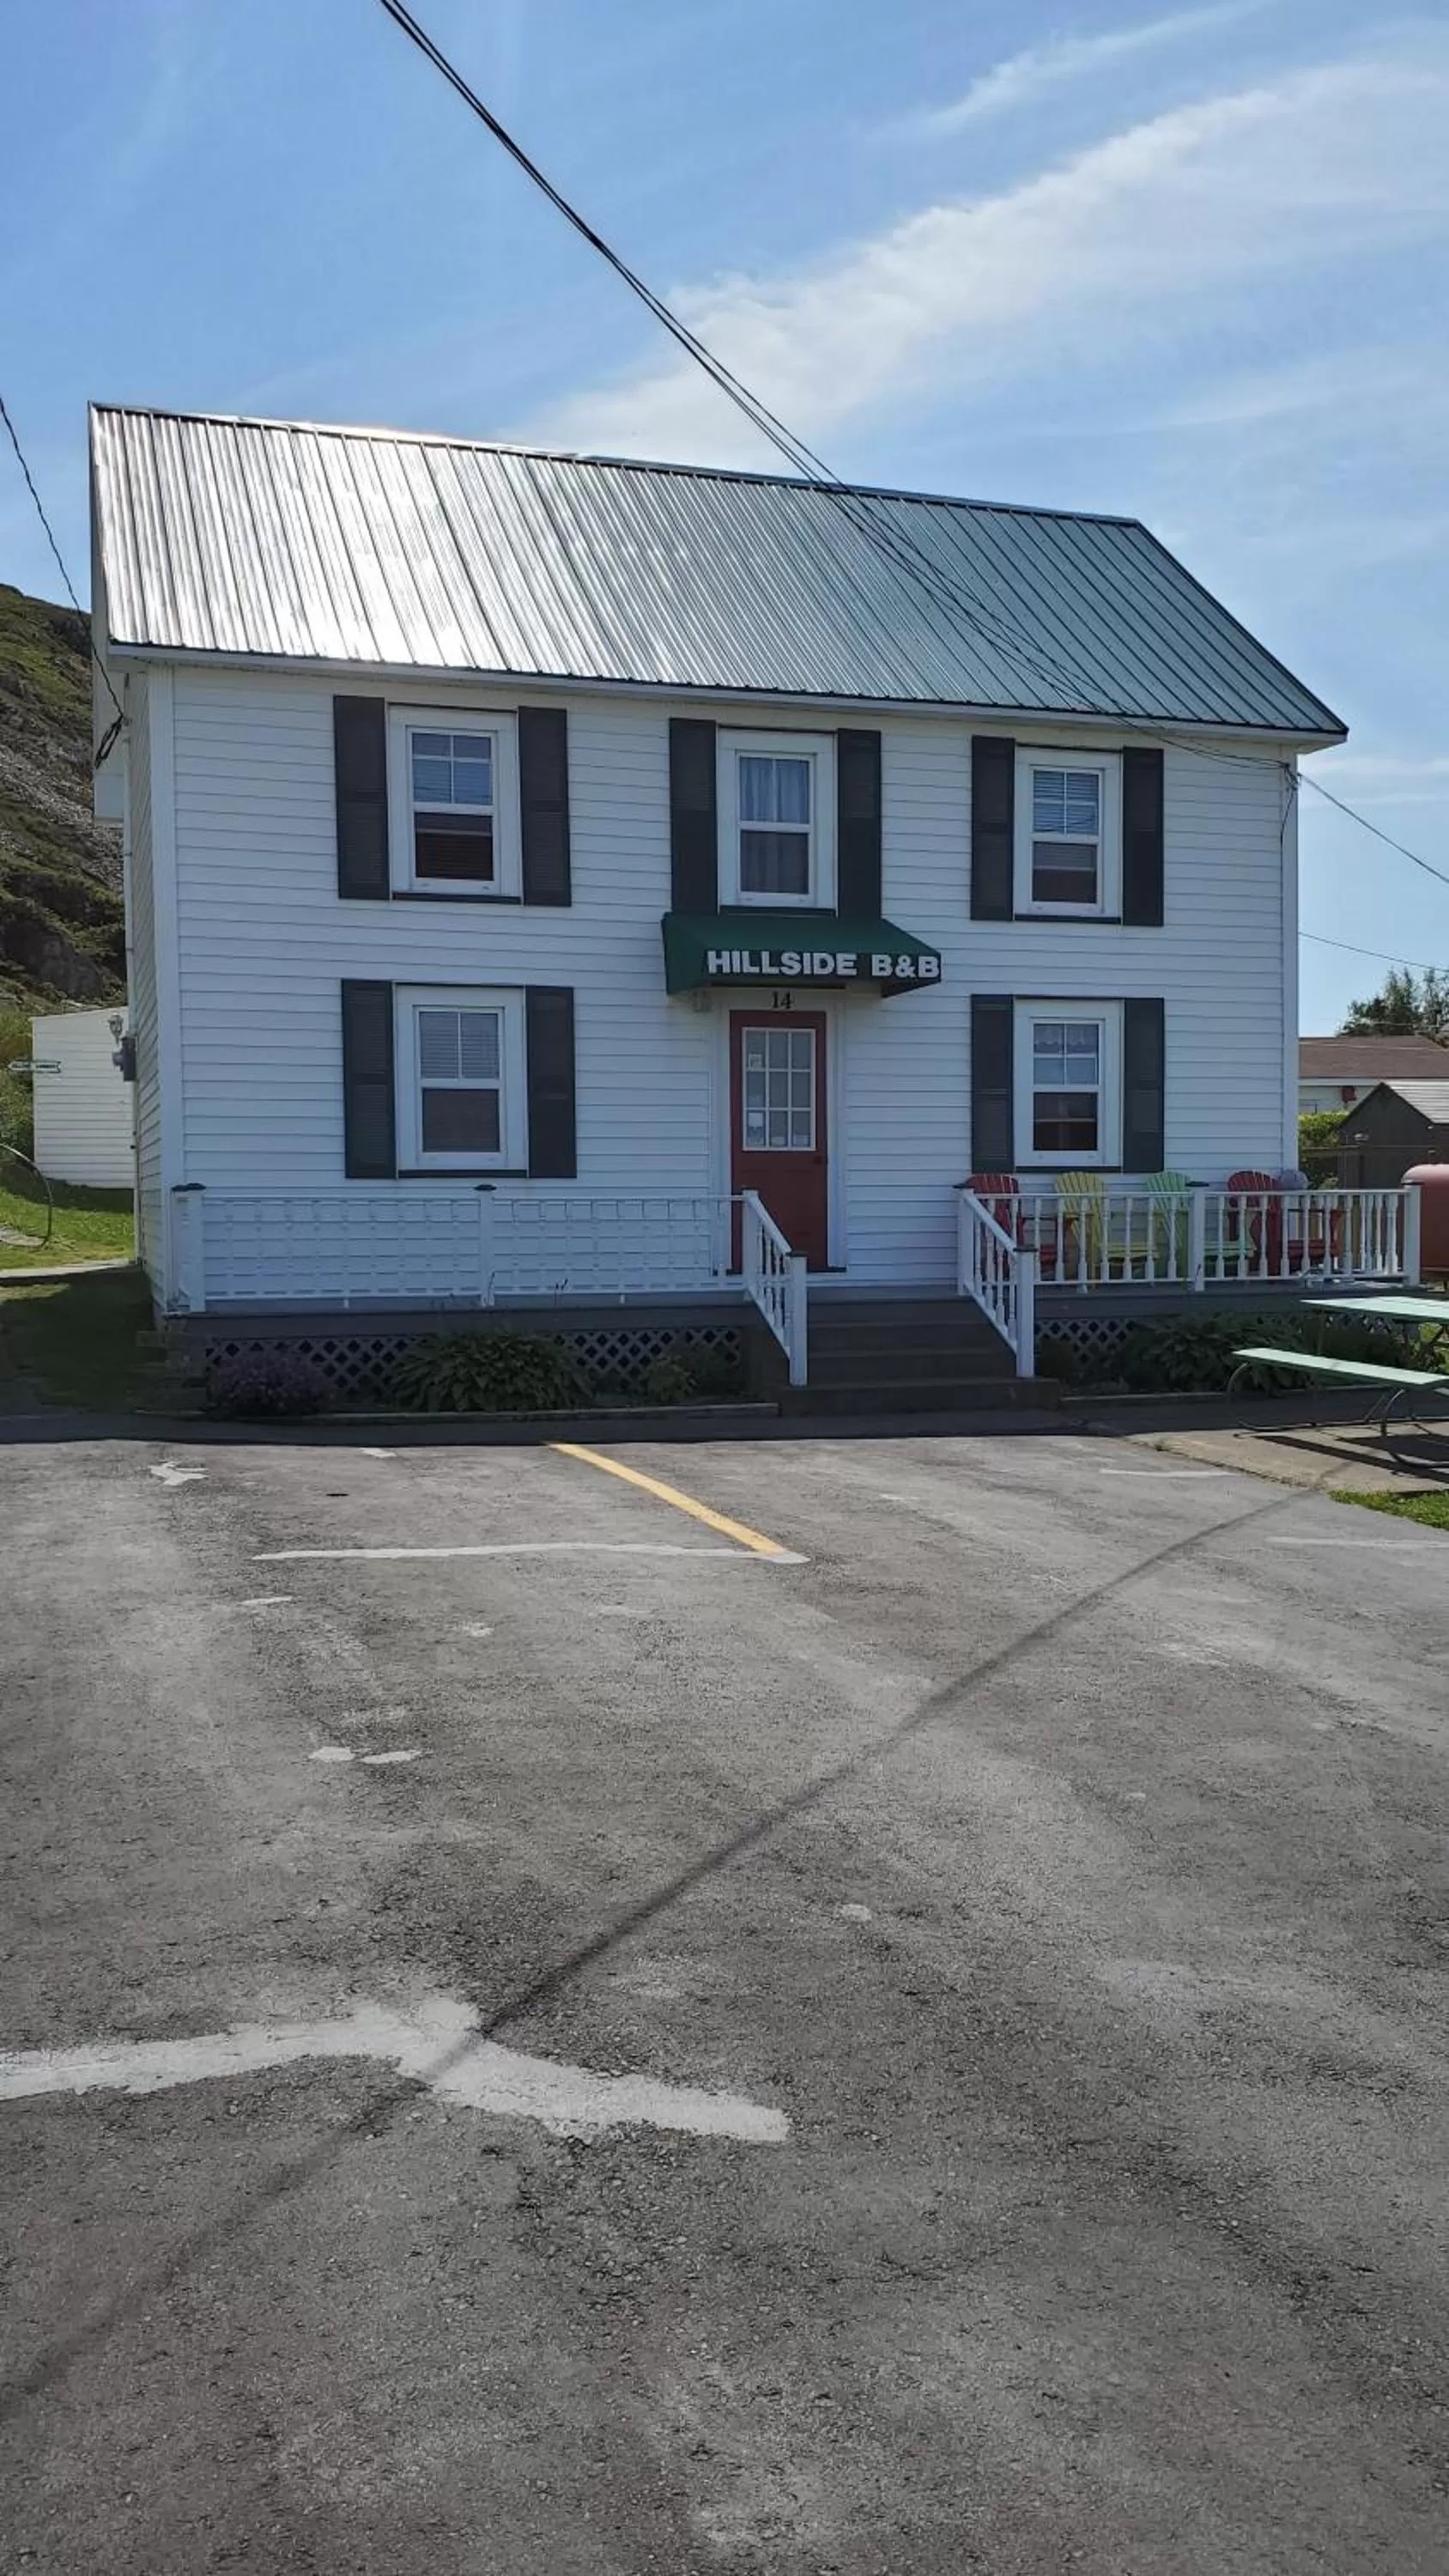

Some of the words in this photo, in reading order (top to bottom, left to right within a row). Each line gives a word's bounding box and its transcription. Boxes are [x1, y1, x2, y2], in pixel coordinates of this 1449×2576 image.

[706, 950, 857, 976] HILLSIDE
[871, 954, 940, 978] B&B
[772, 991, 793, 1009] 14
